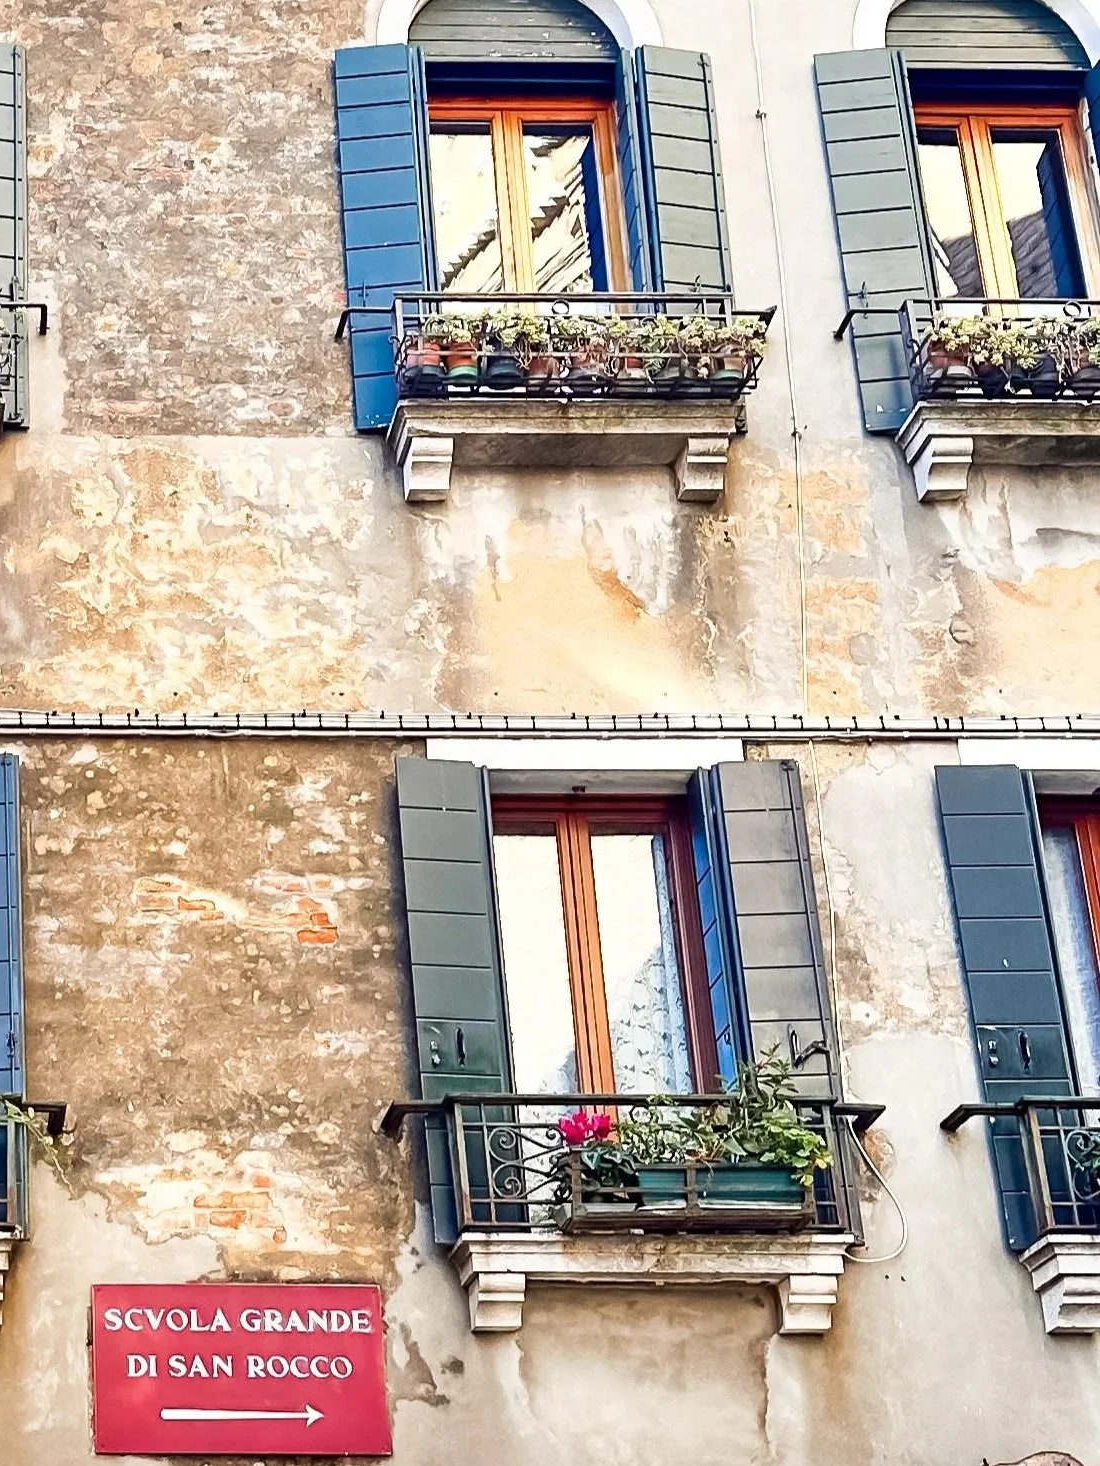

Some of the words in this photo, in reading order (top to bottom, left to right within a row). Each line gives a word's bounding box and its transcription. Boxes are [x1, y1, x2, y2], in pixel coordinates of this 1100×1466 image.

[103, 1308, 232, 1332] SCVOLA
[239, 1309, 373, 1333] GRANDE
[127, 1355, 158, 1378] DI
[168, 1355, 234, 1378] SAN
[247, 1355, 353, 1379] ROCCO
